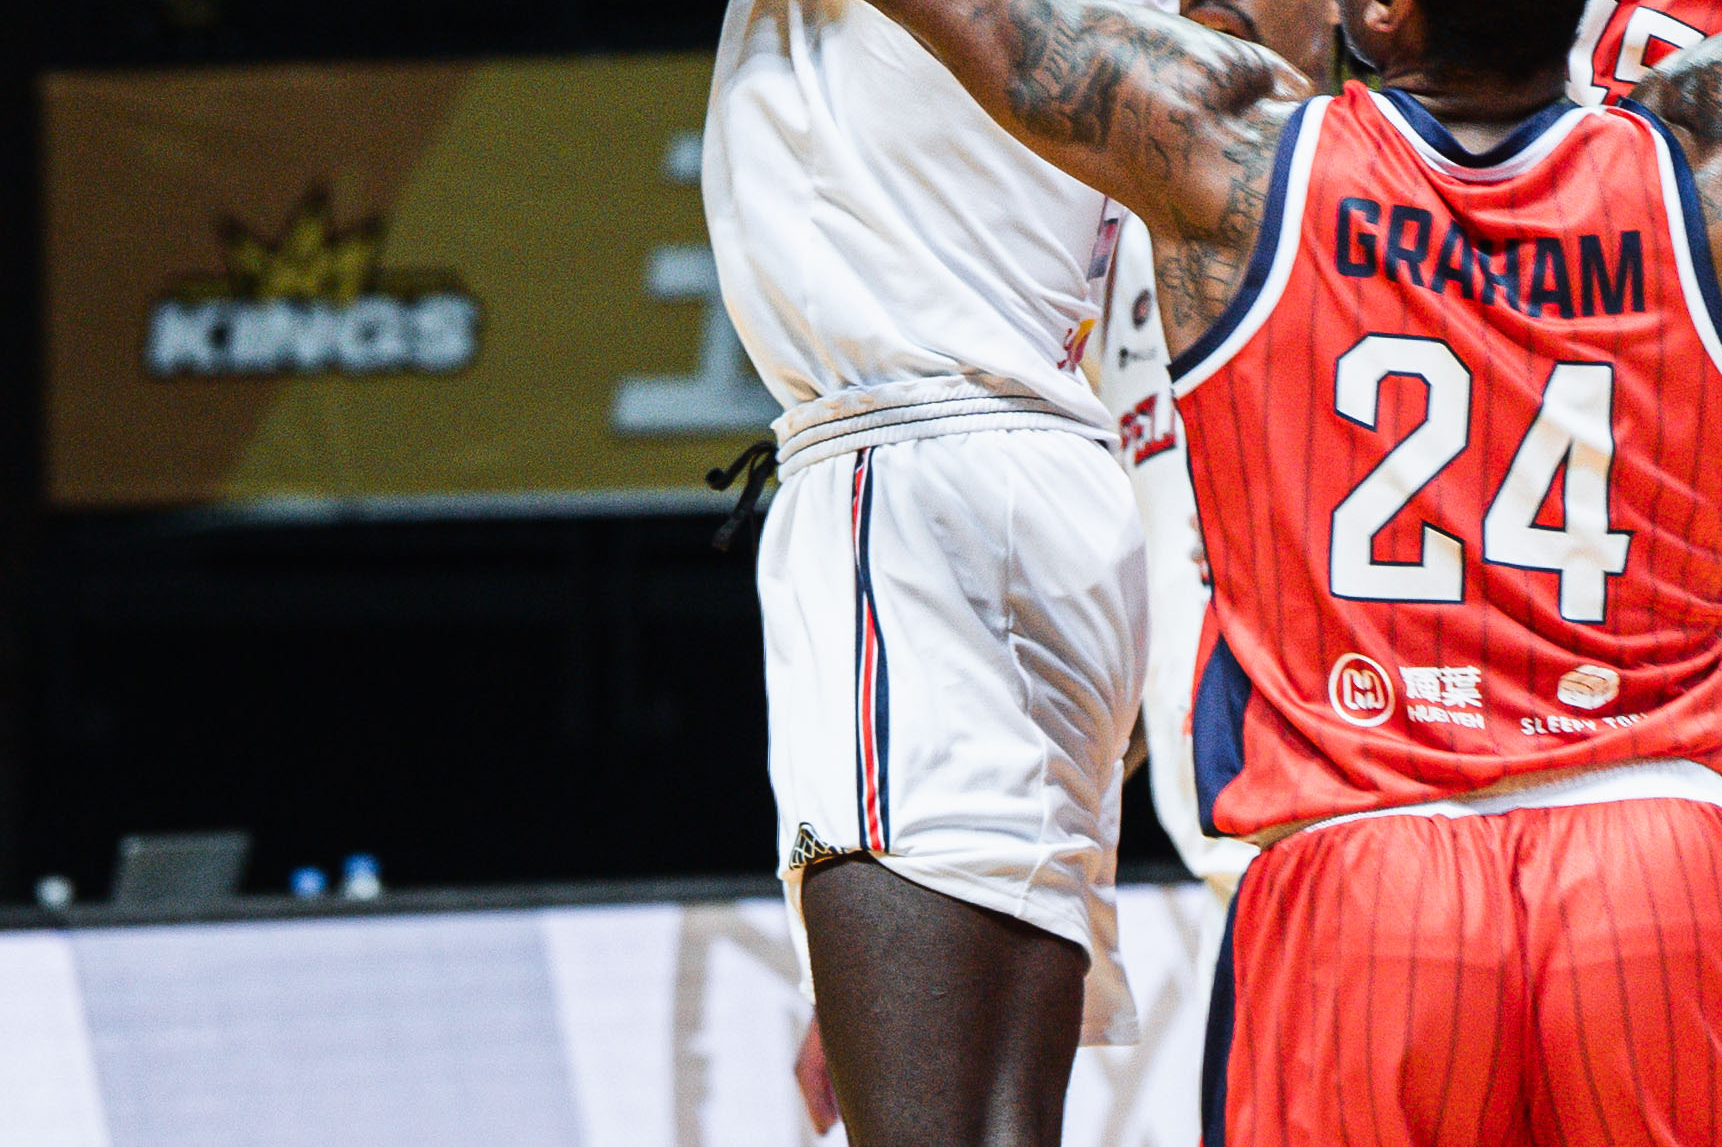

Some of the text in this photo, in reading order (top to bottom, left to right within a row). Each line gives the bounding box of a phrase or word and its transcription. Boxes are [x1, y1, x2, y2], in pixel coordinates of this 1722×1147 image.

[1336, 196, 1646, 318] GRAHAM
[148, 295, 480, 375] KINGS
[1330, 333, 1632, 624] 24
[1520, 715, 1597, 736] SLEEPY
